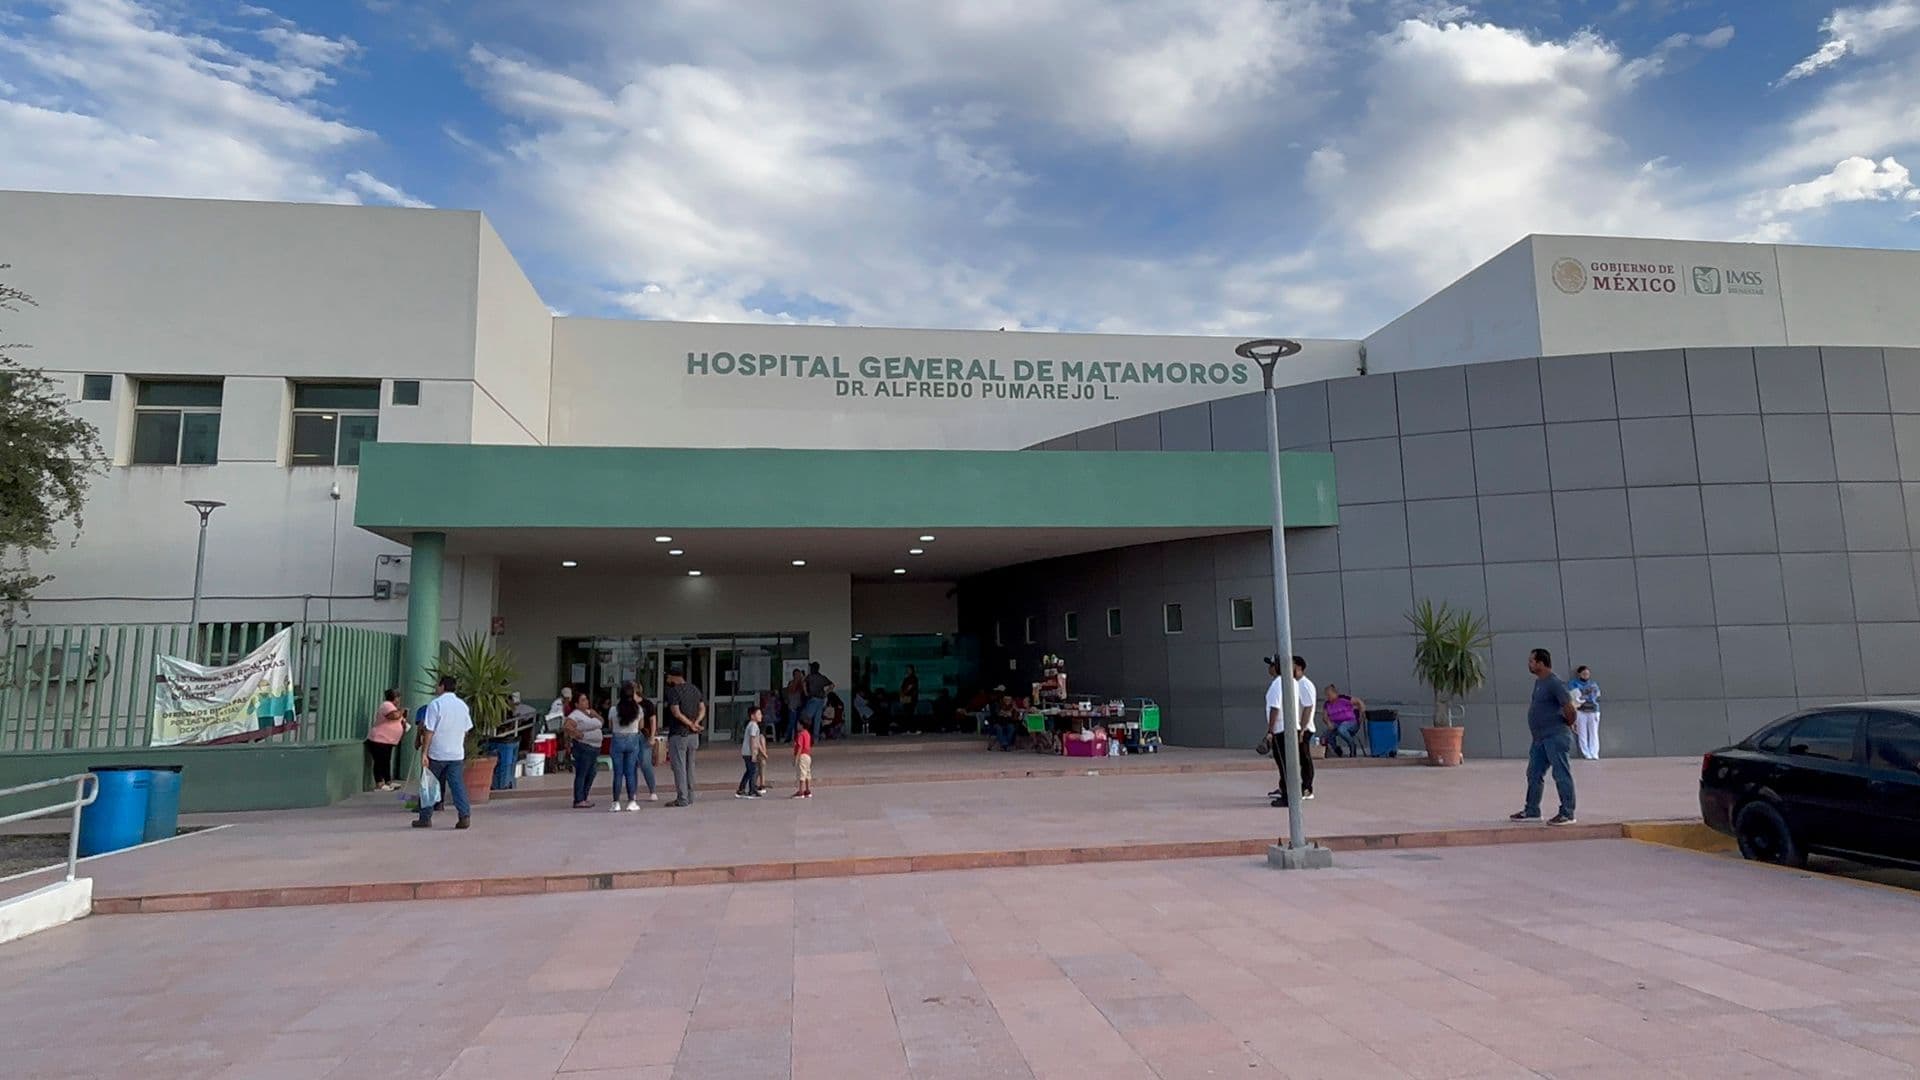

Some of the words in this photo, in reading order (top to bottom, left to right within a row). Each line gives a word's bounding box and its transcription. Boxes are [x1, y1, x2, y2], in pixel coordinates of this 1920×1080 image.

[1591, 262, 1656, 274] GOBIERNO
[1659, 265, 1675, 274] DE
[1726, 270, 1763, 286] IMSS
[1593, 273, 1676, 293] MÉXICO
[687, 352, 849, 379] HOSPITAL
[859, 357, 1005, 381] GENERAL
[1014, 360, 1053, 382] DE
[1062, 361, 1249, 385] MATAMOROS
[836, 379, 869, 397] DR.
[874, 380, 973, 399] ALFREDO
[982, 381, 1096, 401] PUMAREJO
[1103, 384, 1120, 401] L.
